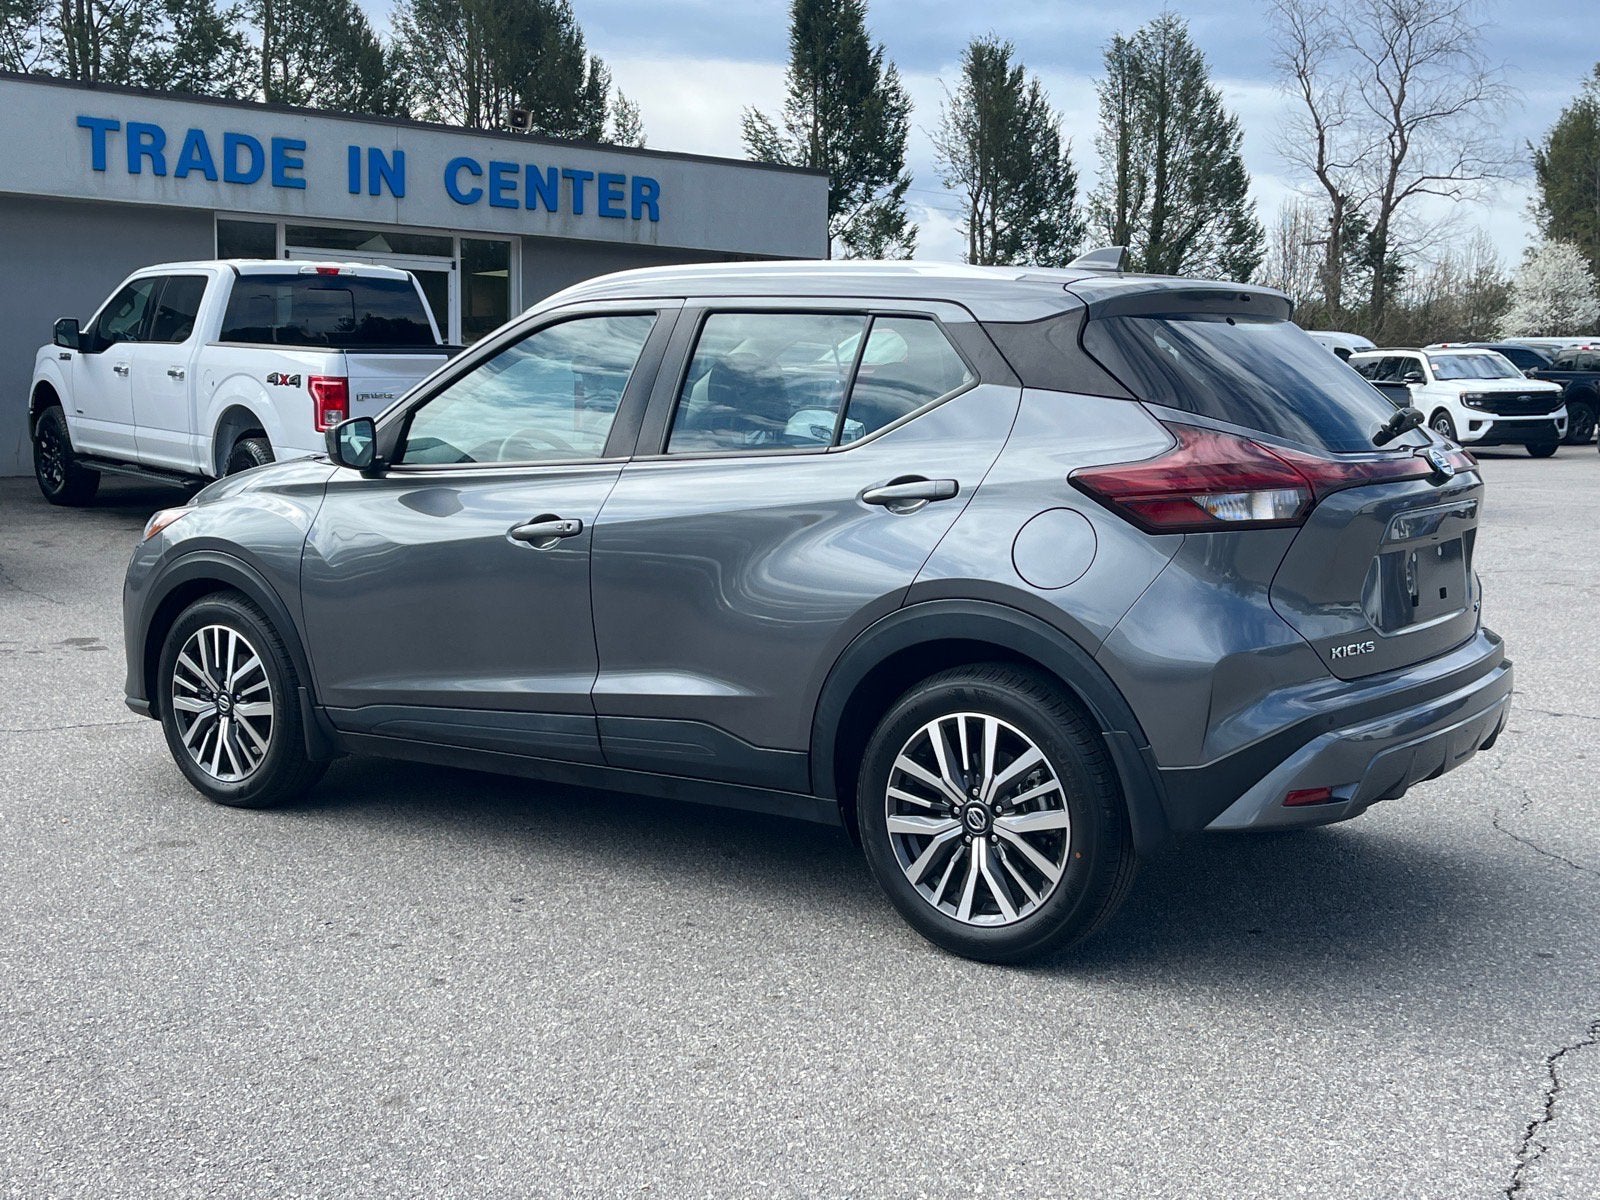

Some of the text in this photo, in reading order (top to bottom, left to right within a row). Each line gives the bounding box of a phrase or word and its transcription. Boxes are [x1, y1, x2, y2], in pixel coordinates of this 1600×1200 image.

[76, 115, 661, 222] TRADE IN CENTER
[1331, 640, 1376, 660] KICKS
